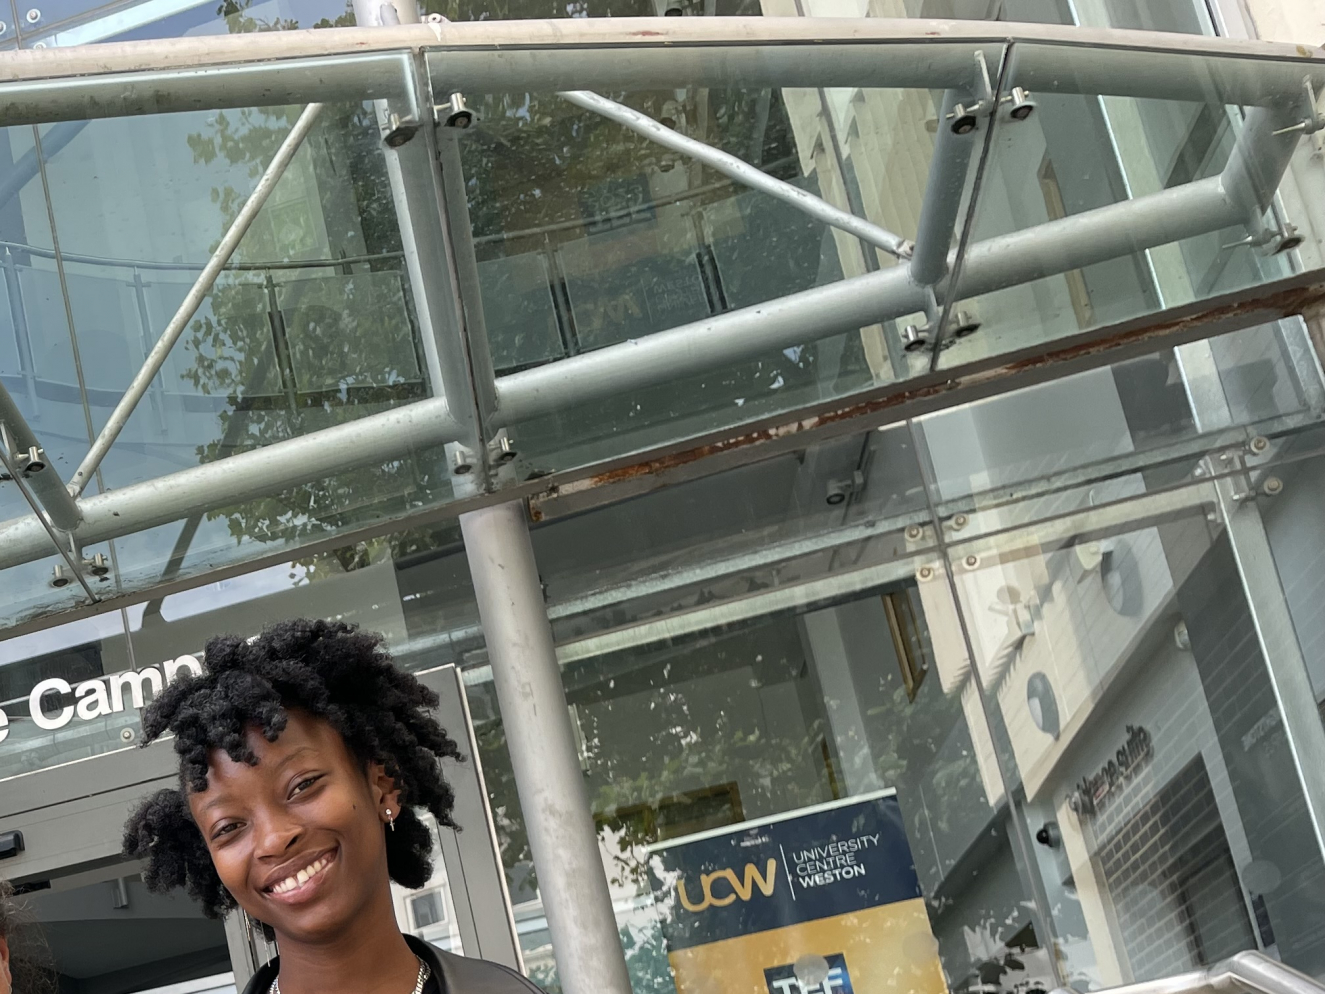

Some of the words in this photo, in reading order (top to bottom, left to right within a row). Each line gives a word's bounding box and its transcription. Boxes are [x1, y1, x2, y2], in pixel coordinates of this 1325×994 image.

[29, 654, 203, 730] Camp
[793, 834, 880, 864] UNIVERSITY
[796, 852, 857, 876] CENTRE
[676, 858, 776, 912] UCW
[799, 864, 866, 888] WESTON
